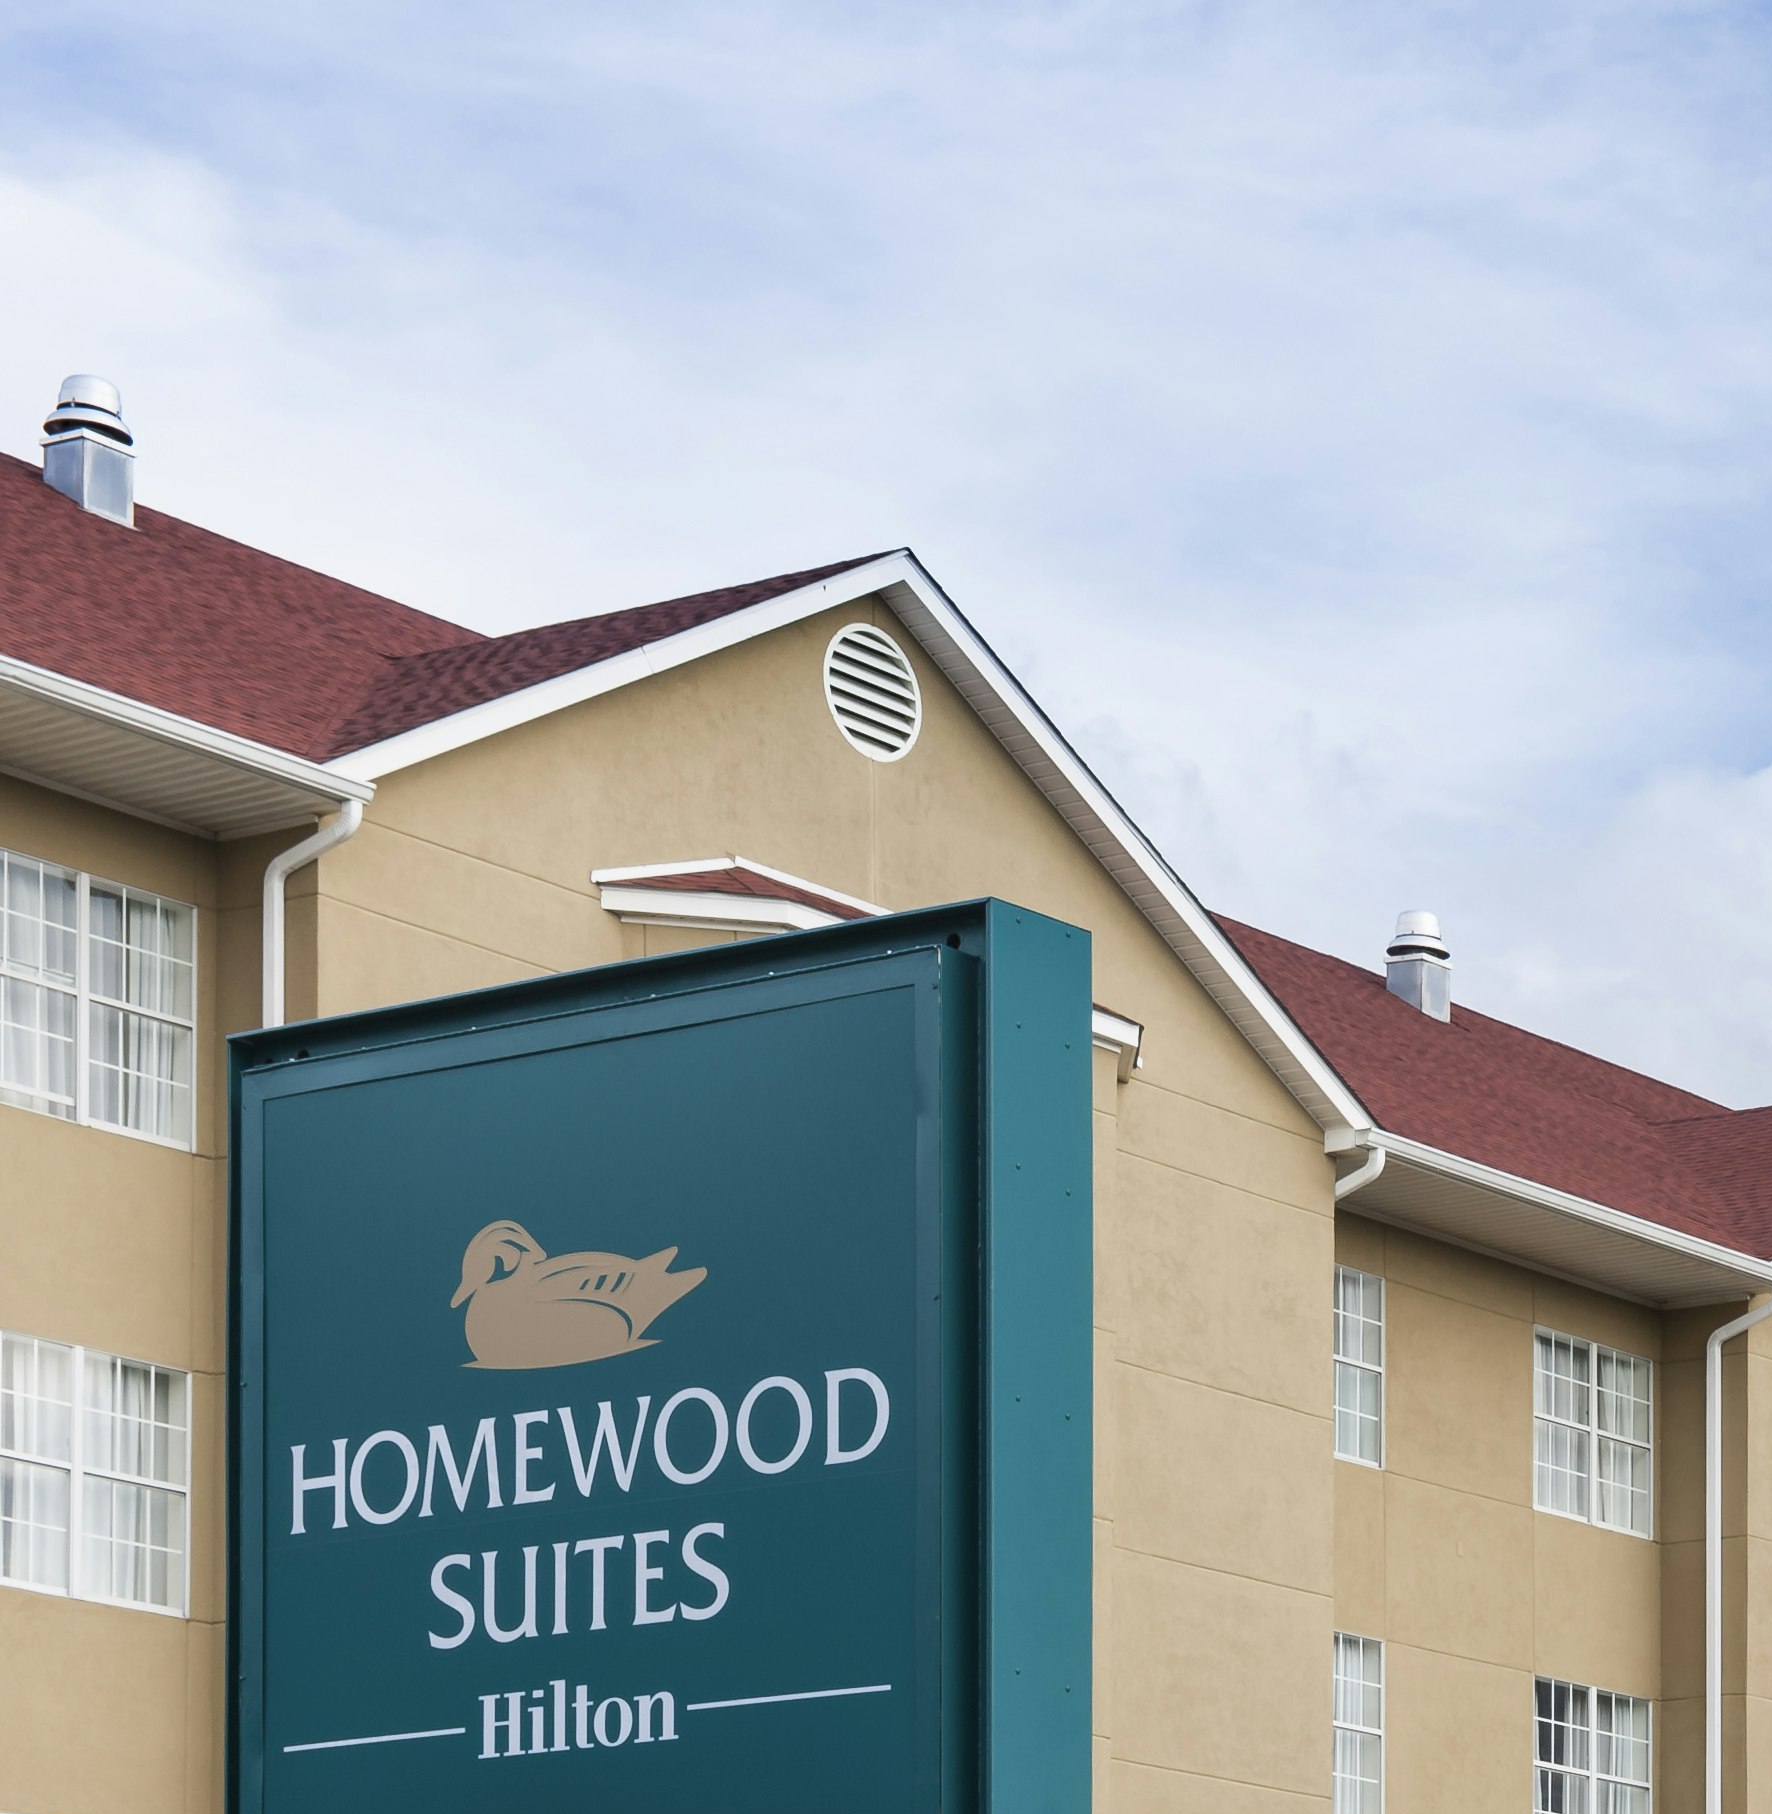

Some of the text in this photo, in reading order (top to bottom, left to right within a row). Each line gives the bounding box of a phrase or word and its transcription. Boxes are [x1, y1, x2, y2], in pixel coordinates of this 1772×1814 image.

[289, 1366, 891, 1536] HOMEWOOD
[427, 1521, 731, 1651] SUITES
[476, 1679, 680, 1761] Hilton
